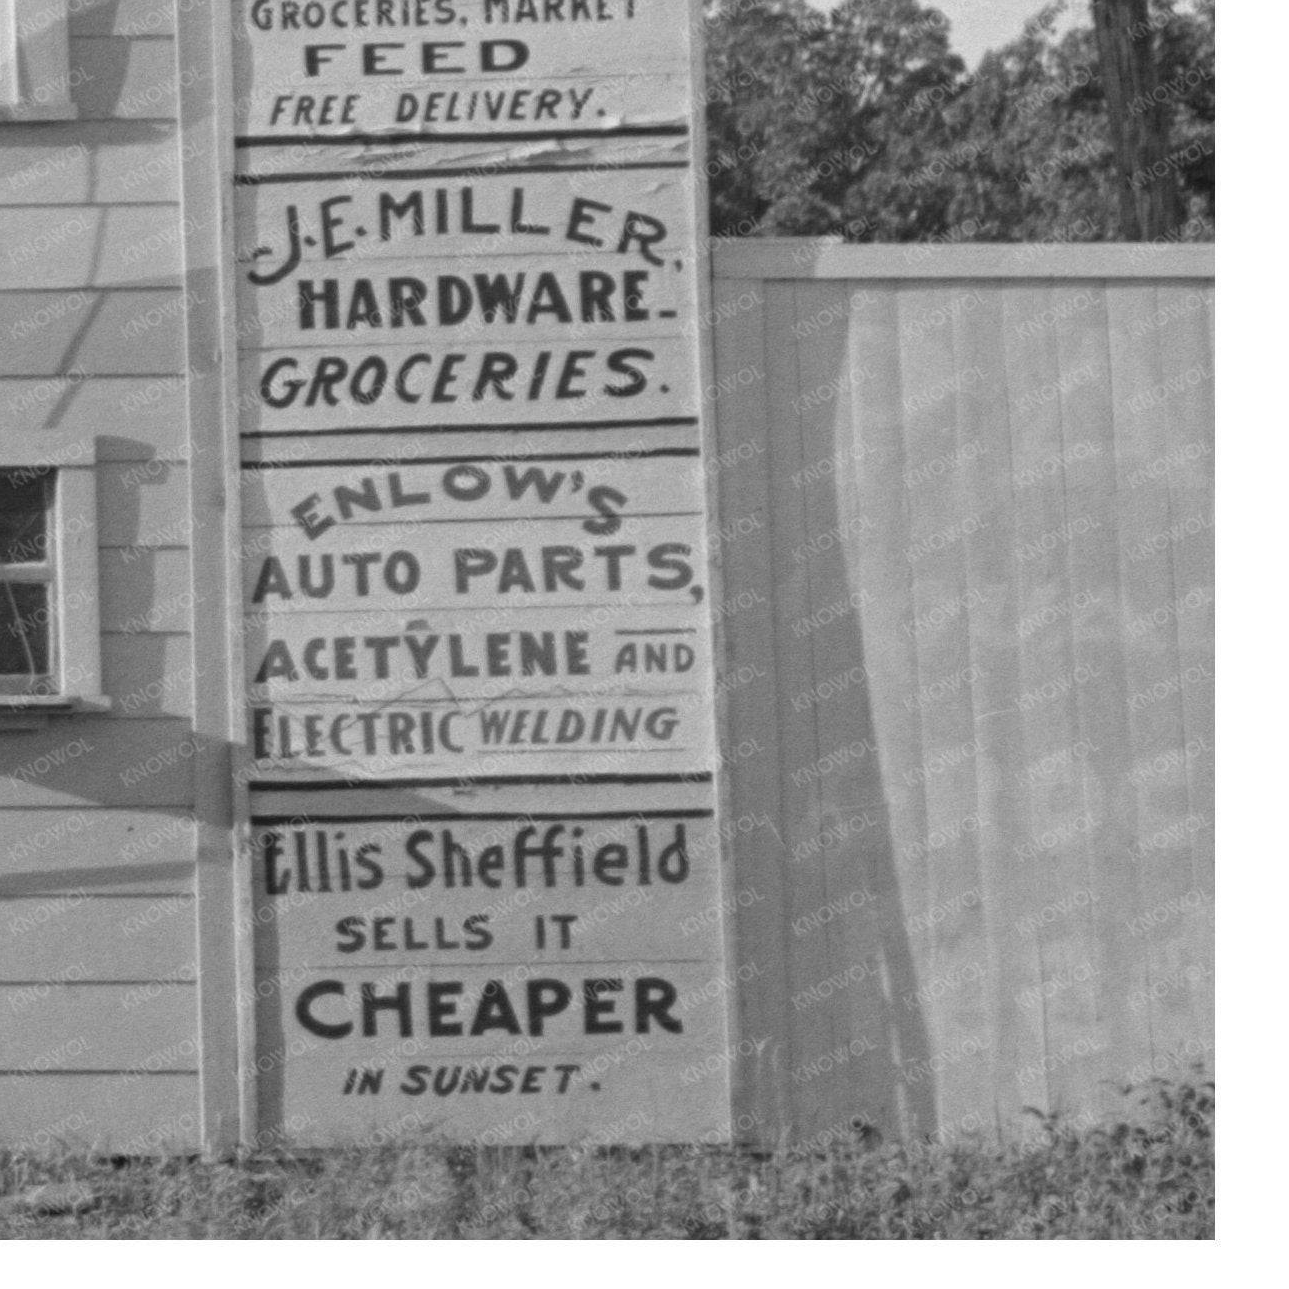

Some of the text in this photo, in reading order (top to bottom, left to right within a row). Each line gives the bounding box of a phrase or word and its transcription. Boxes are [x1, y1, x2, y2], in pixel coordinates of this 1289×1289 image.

[304, 38, 530, 77] FEED
[270, 87, 606, 127] FREE DELIVERY.
[259, 347, 671, 409] GROCERIES.
[290, 463, 629, 541] ENLOW'S
[252, 542, 705, 605] AUTO PARTS,
[254, 629, 696, 684] ACETYLENE AND
[254, 706, 680, 761] ELECTRIC WELDING
[263, 822, 690, 896] Ellis Sheffield
[335, 914, 579, 953] SELLS IT
[295, 977, 684, 1039] CHEAPER
[342, 1064, 602, 1097] IN SUNSET.
